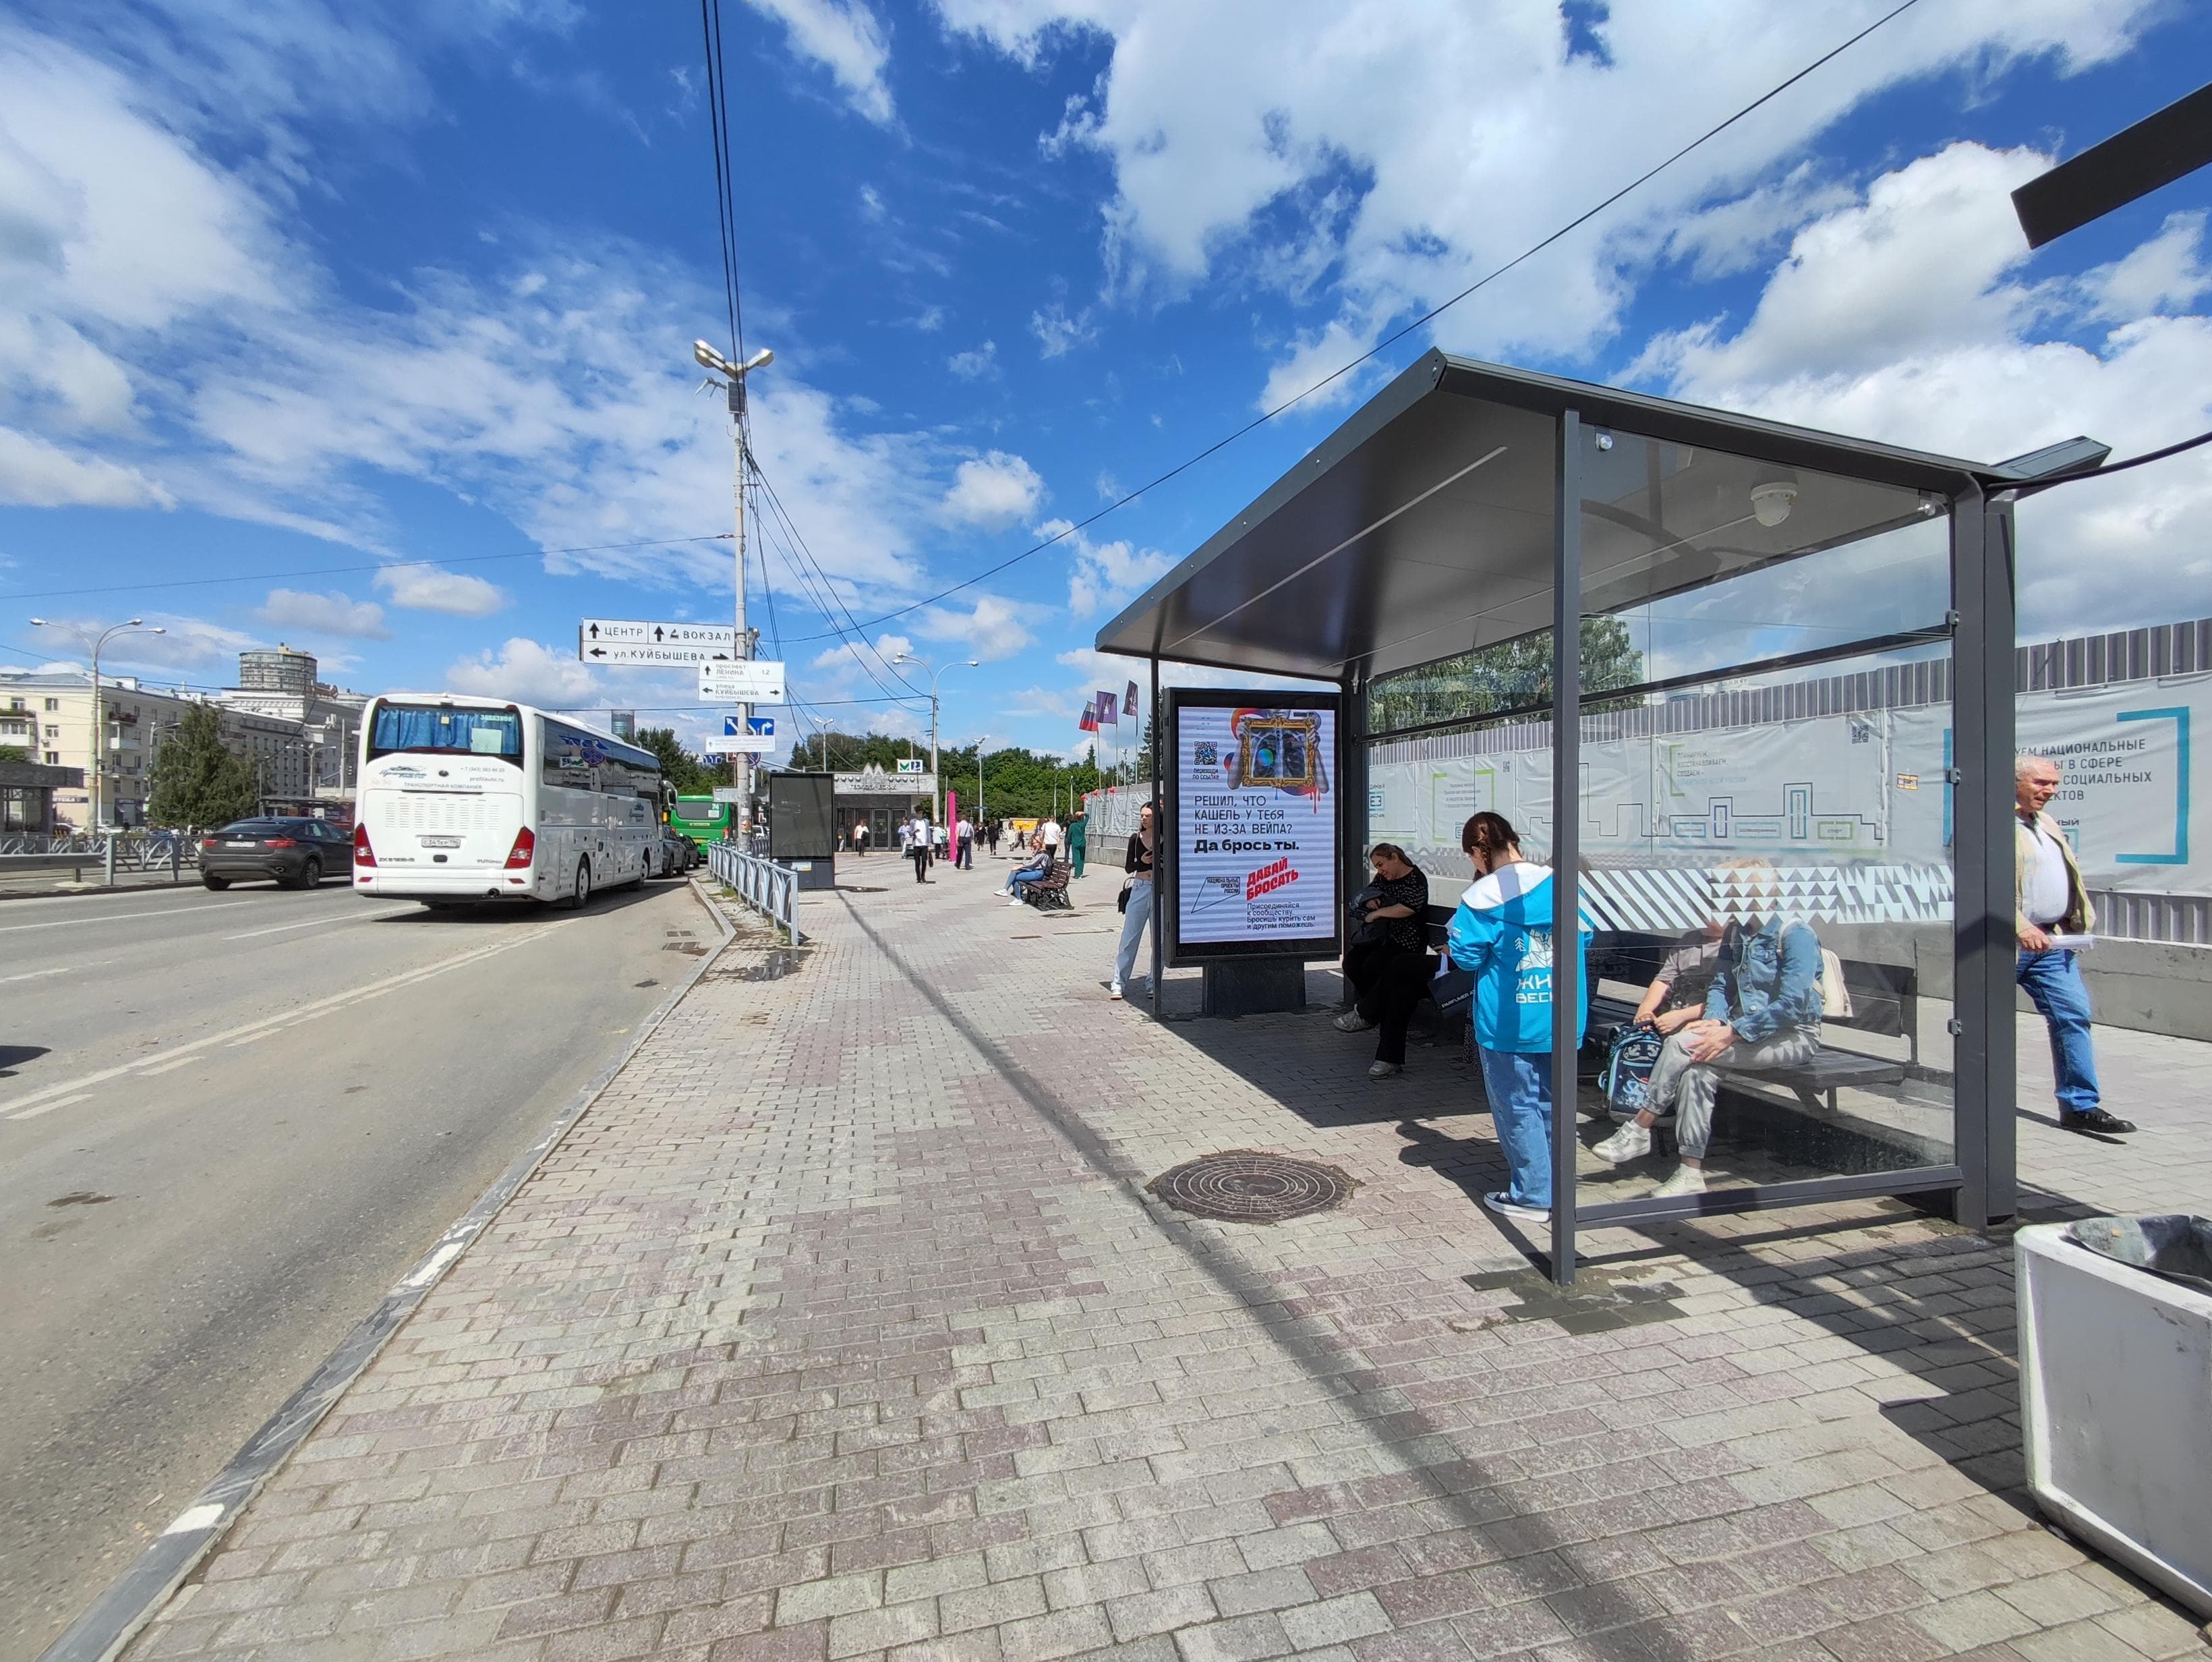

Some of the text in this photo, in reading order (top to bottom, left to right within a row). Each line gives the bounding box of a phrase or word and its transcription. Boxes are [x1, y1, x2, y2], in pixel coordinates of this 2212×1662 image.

[605, 627, 643, 637] ЦЕНТР
[683, 630, 731, 641] ВОКЗАЛ
[2041, 739, 2147, 756] НАЦИОНАЛЬНЫЕ
[2068, 760, 2076, 770] В
[2080, 757, 2122, 769] СФЕРЕ
[2064, 771, 2153, 786] СОЦИАЛЬНЫХ
[1194, 795, 1267, 807] РЕШИЛ, ЧТО
[1194, 809, 1240, 820] КАШЕЛЬ
[1246, 809, 1252, 820] У
[1194, 822, 1293, 834] НЕ ИЗ-ЗА ВЕЙПА?
[1194, 839, 1299, 854] Да брось ты.
[1247, 857, 1288, 887] ДАВАЙ
[1246, 869, 1299, 901] БРОСАТЬ
[1247, 902, 1300, 911] Присоединяйся
